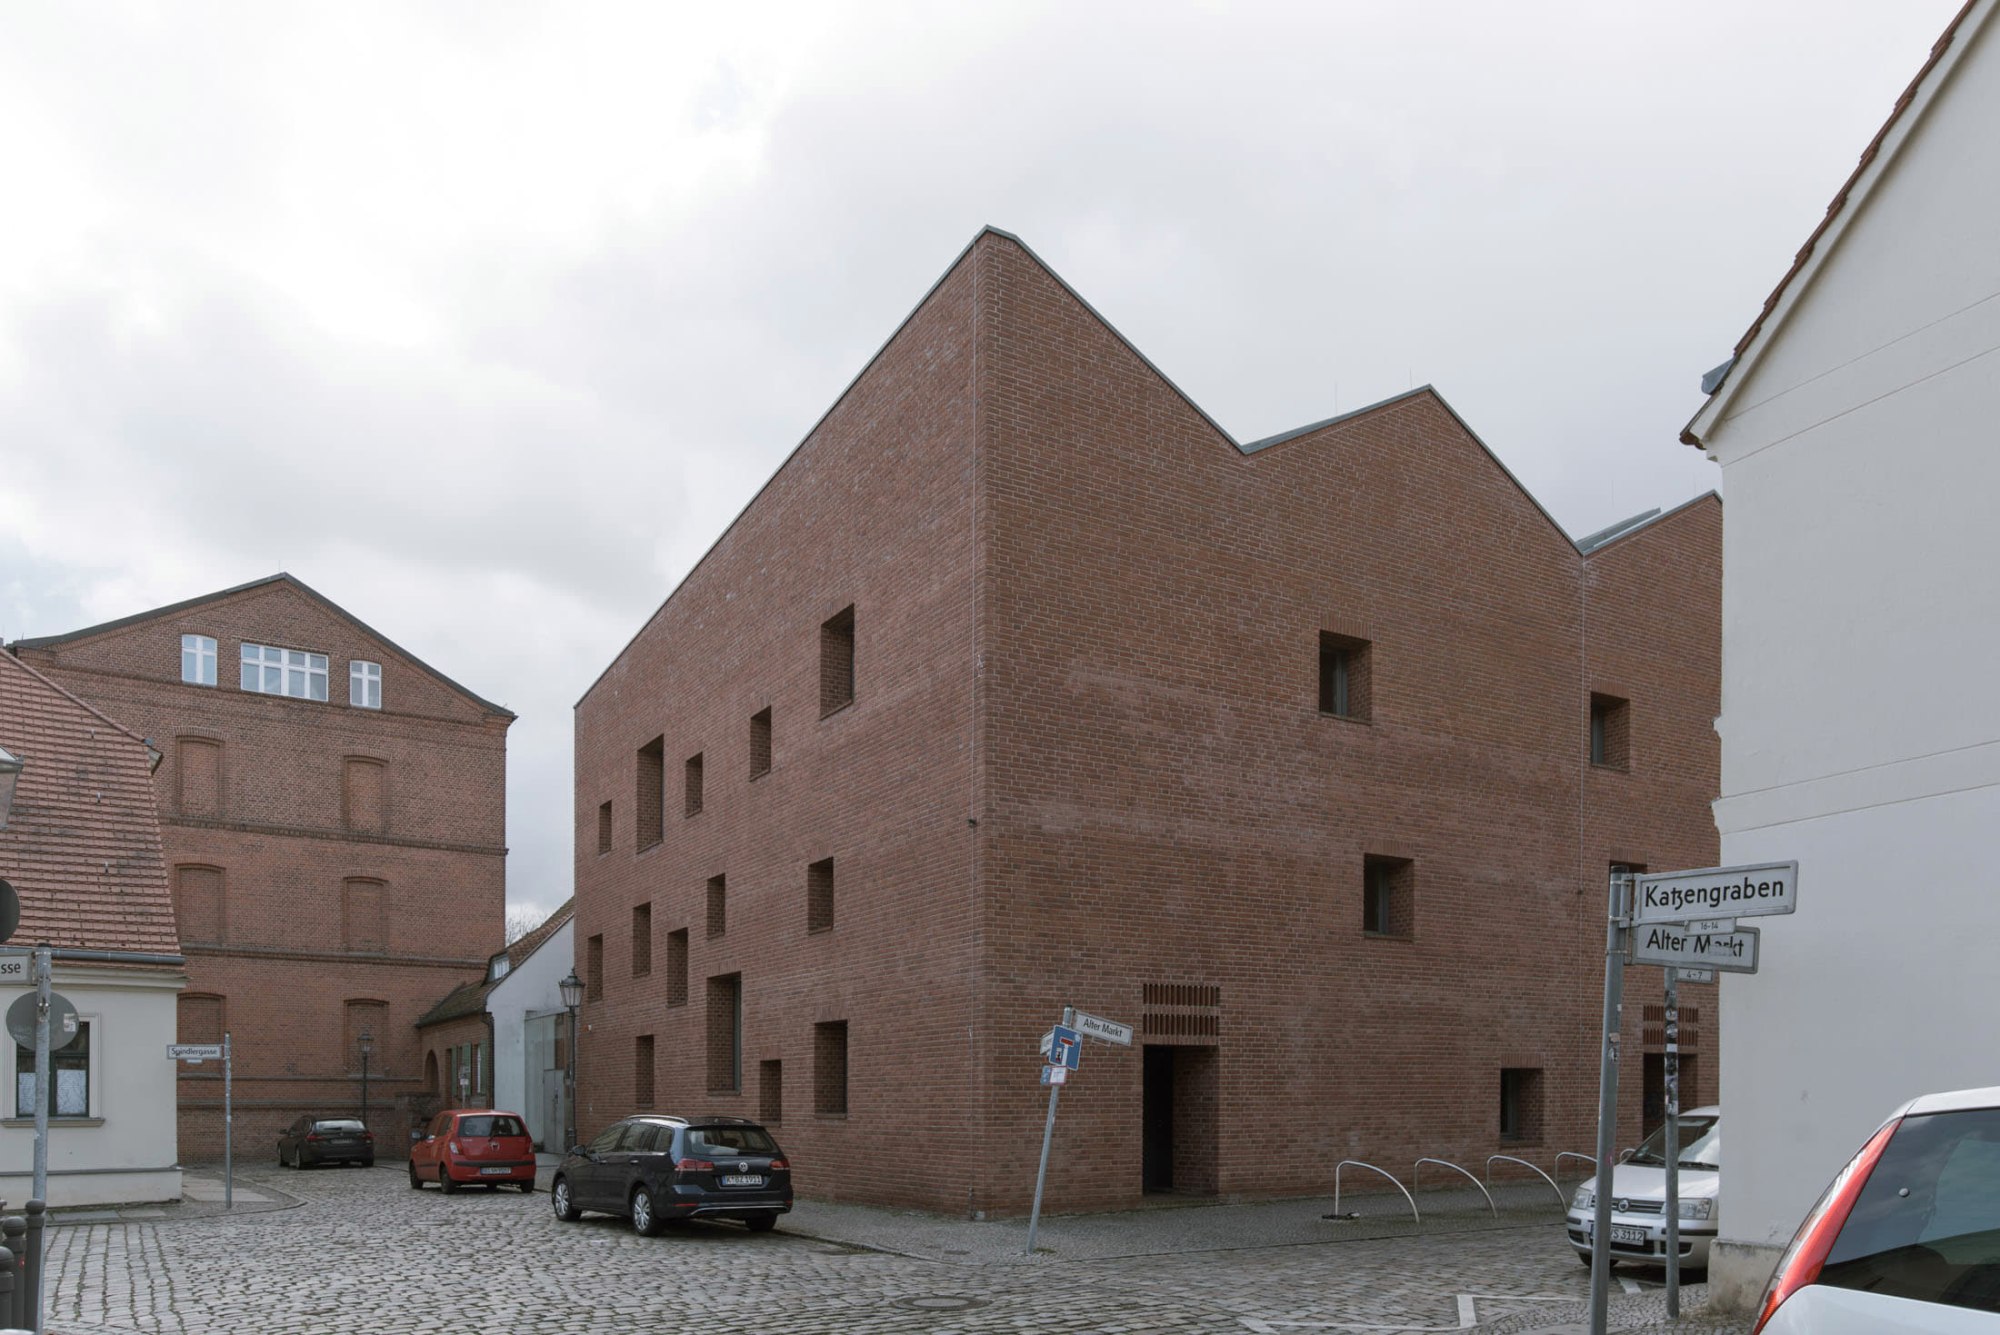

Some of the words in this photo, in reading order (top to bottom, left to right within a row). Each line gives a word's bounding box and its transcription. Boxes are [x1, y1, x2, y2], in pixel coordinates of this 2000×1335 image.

[1646, 928, 1687, 952] Alter
[1083, 1018, 1101, 1031] Alter
[1102, 1023, 1123, 1038] Markt
[171, 1047, 218, 1056] Spindlergasse
[1620, 1230, 1644, 1242] 3112
